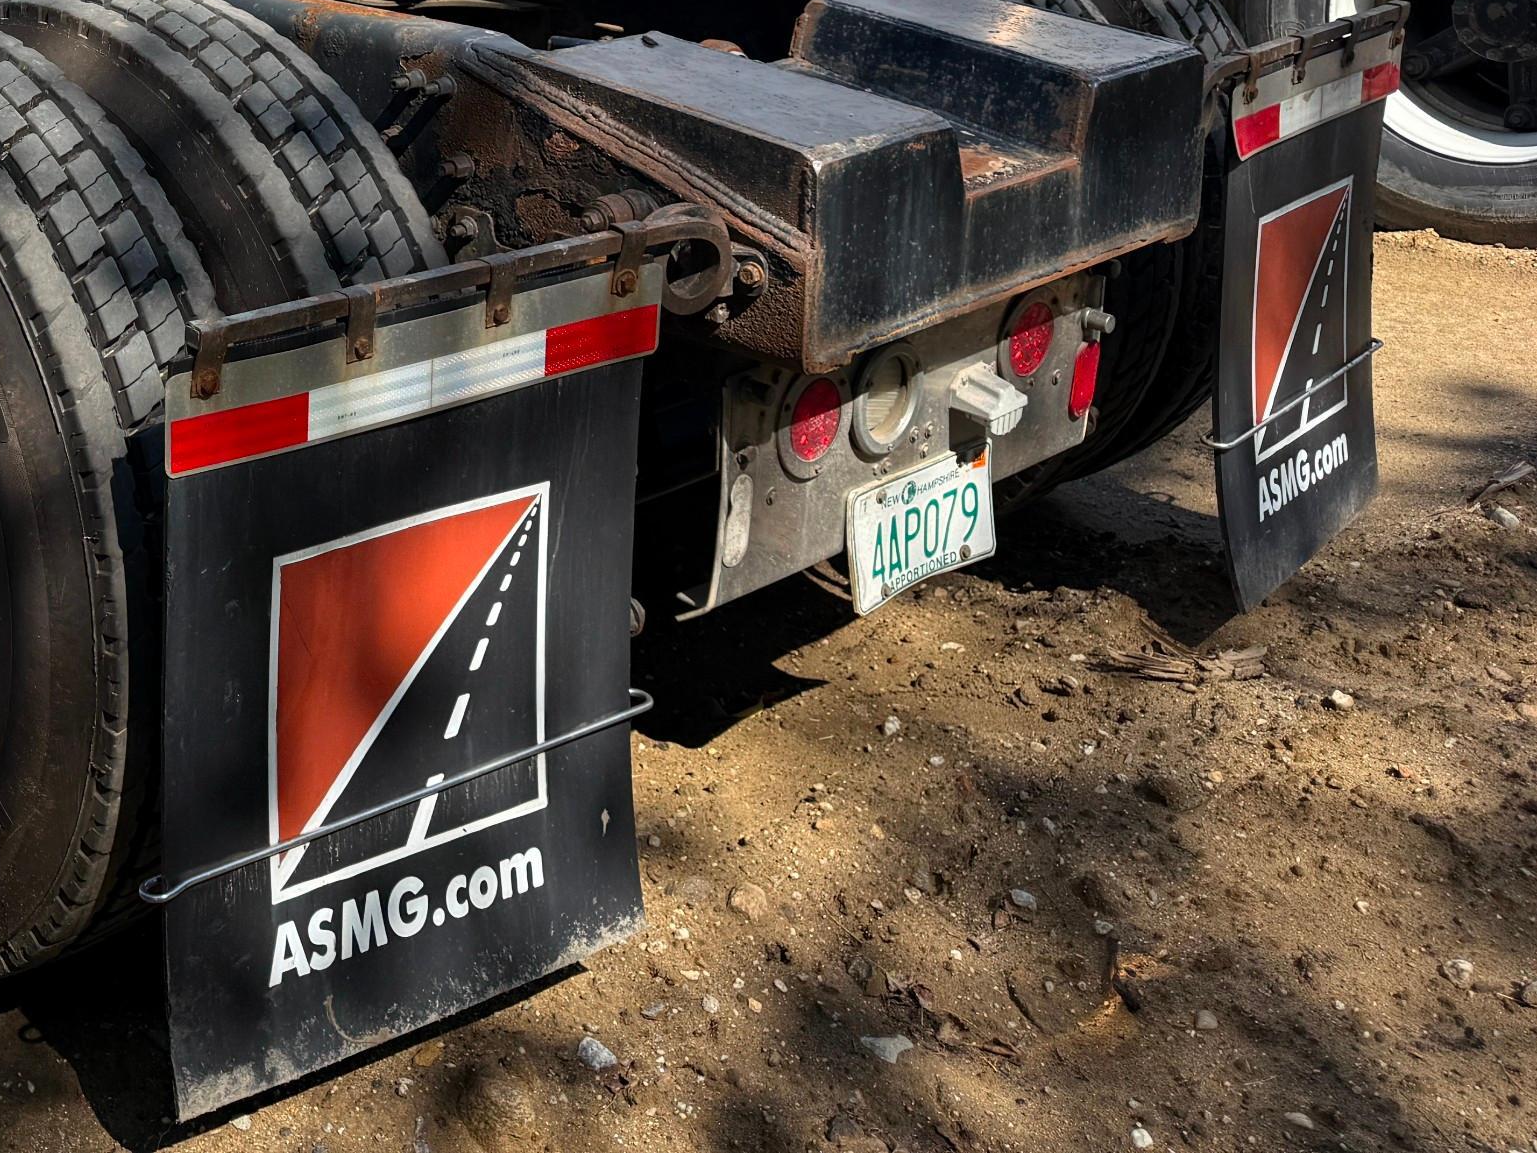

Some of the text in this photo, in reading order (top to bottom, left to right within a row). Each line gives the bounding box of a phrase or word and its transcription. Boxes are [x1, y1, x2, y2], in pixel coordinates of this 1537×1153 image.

[881, 492, 901, 510] NEW
[916, 468, 960, 496] HAMPSHIRE
[1258, 433, 1349, 523] ASMG.com
[871, 482, 979, 584] 4AP079
[889, 551, 957, 593] APPORTIONED
[268, 845, 545, 988] ASMG.com
